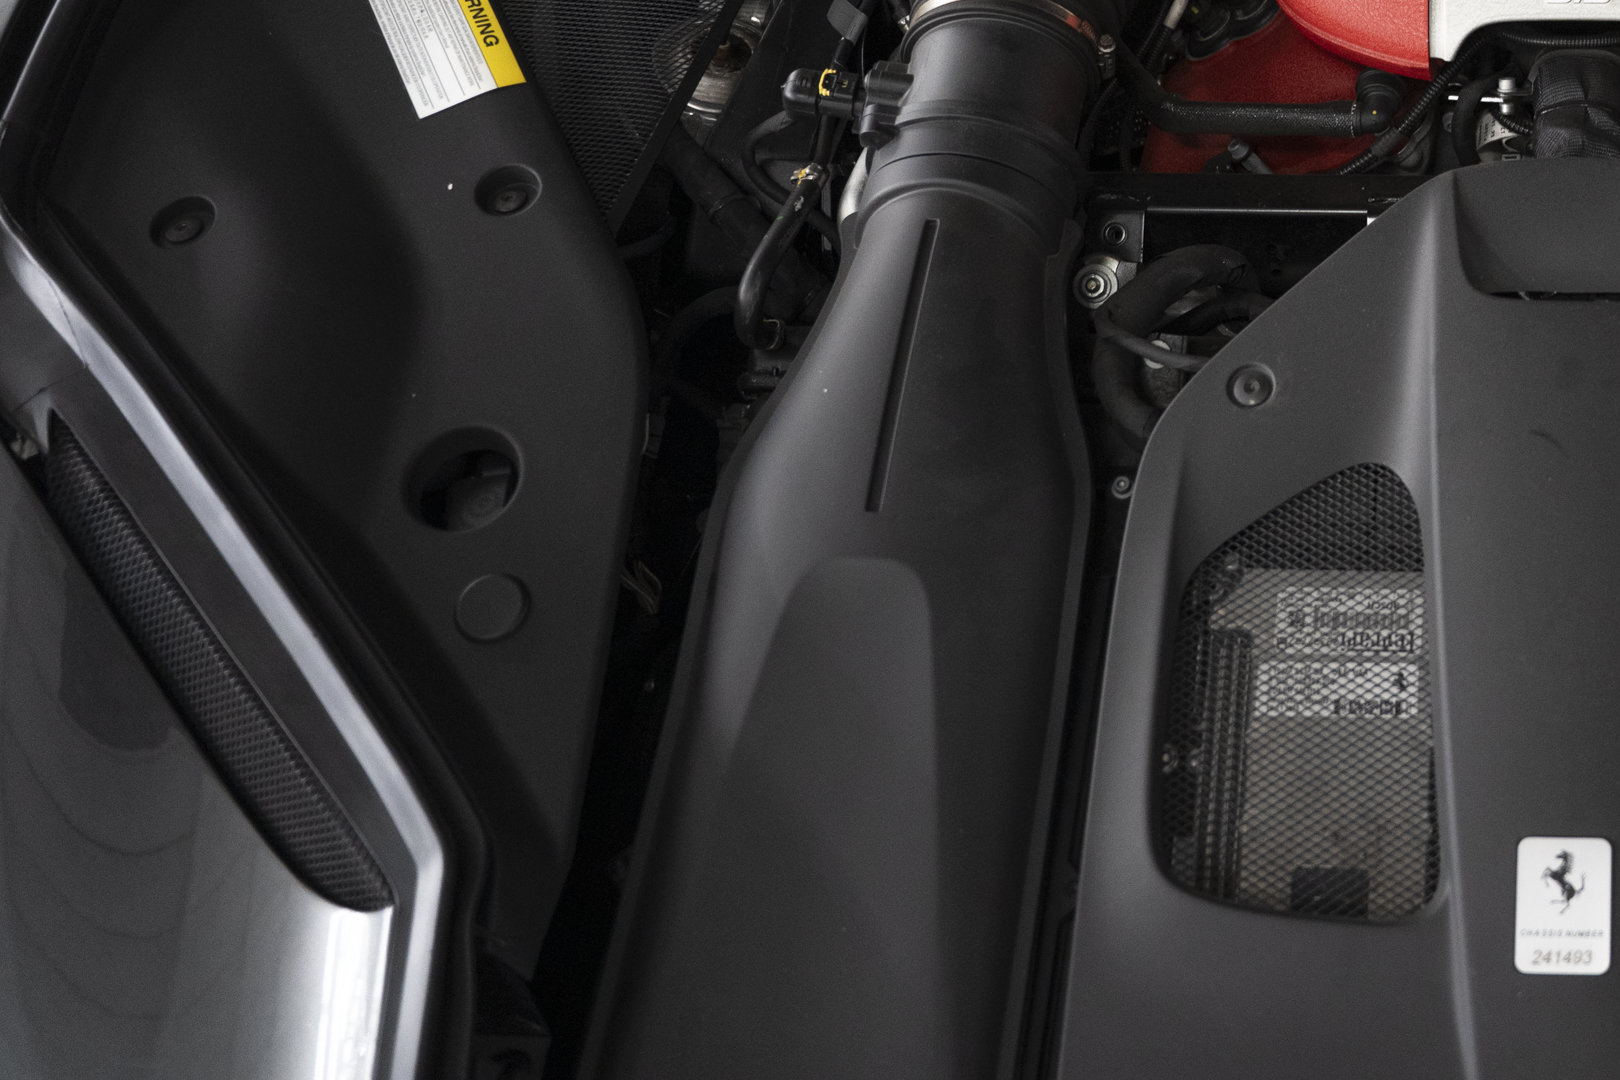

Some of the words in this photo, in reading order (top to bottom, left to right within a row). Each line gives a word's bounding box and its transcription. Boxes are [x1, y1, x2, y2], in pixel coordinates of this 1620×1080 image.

[1519, 927, 1562, 937] CHASSIS
[1564, 927, 1604, 937] NUMBER
[1531, 948, 1593, 964] 241493
